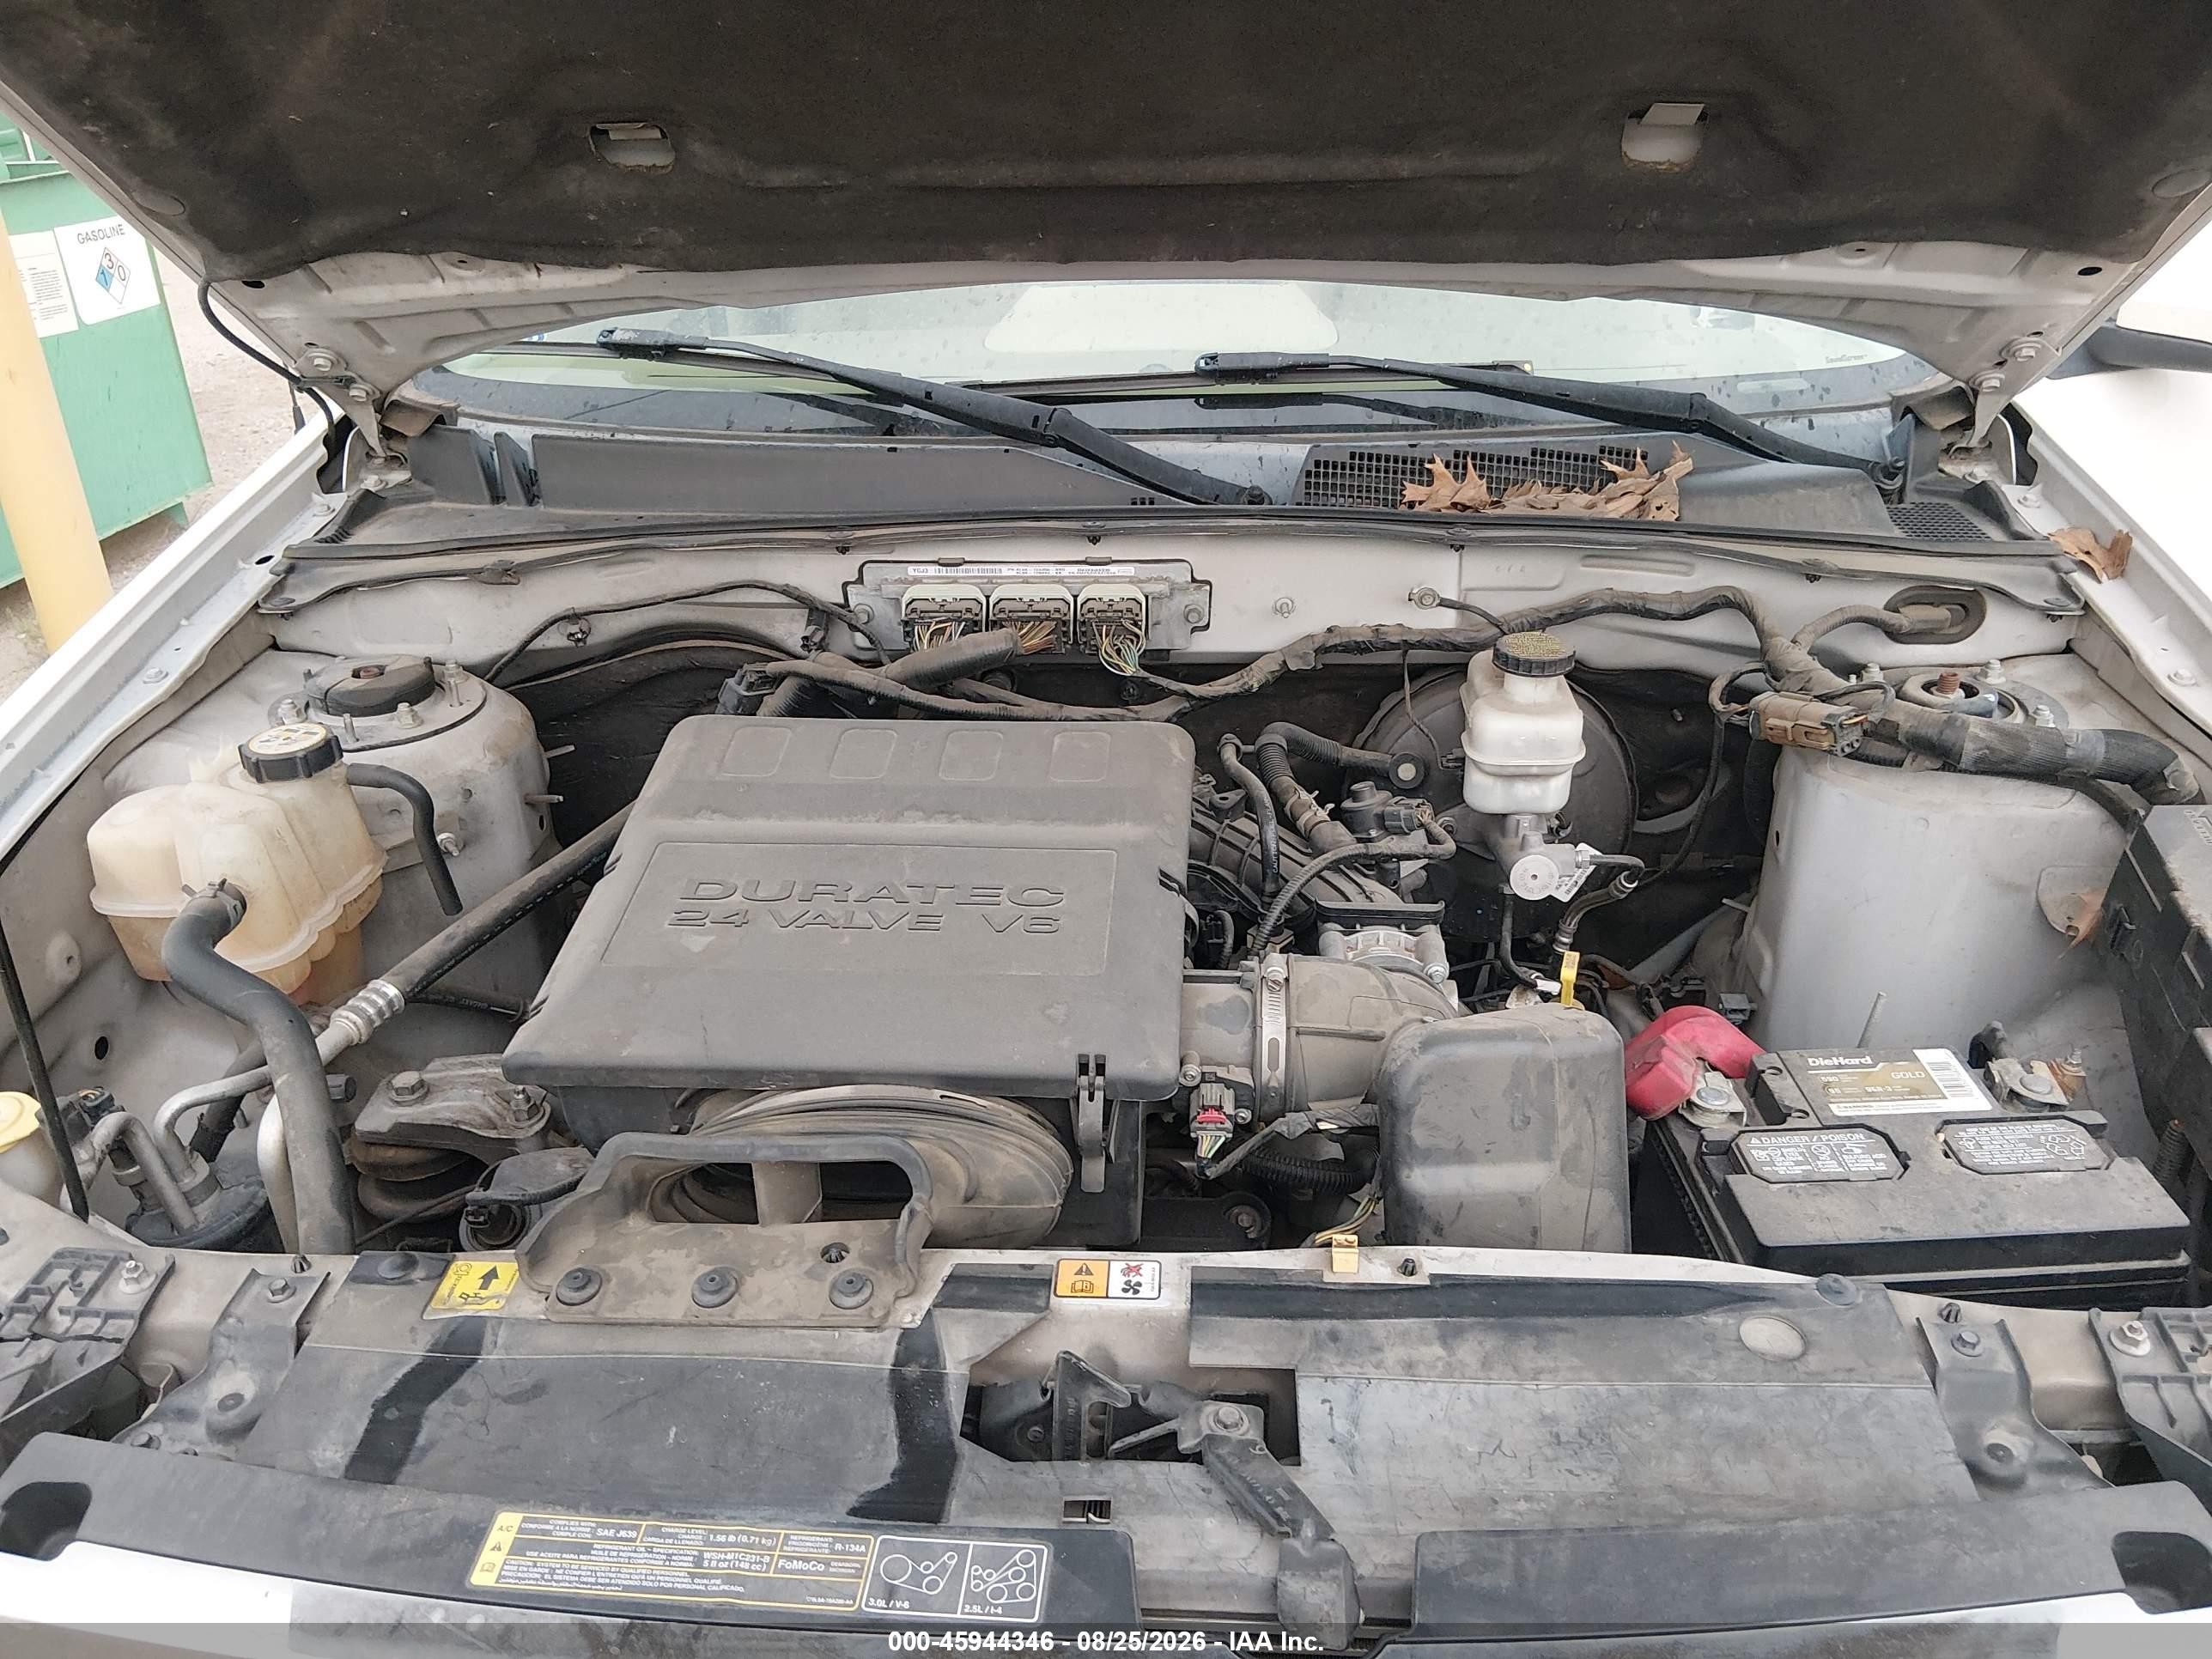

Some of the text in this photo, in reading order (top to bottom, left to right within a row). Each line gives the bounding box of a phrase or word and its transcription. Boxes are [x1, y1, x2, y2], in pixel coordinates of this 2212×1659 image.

[76, 224, 126, 245] GASOLINE
[104, 252, 114, 270] 3
[117, 264, 126, 281] 0
[678, 878, 1065, 908] DURATEC
[666, 908, 1060, 934] 24 VALVE V6
[1807, 1055, 1873, 1066] DieHard
[1891, 1071, 1926, 1079] GOLD
[1760, 1135, 1810, 1144] DANGER
[1820, 1133, 1866, 1142] POISON
[596, 1528, 637, 1539] SAE J639
[708, 1534, 726, 1542] 1.56
[738, 1534, 760, 1544] (0.71
[761, 1536, 776, 1547] kg)
[835, 1543, 866, 1553] R-134A
[703, 1551, 770, 1563] WSH-M1C231-B
[751, 1563, 767, 1571] cc)
[778, 1559, 825, 1571] FoMoCo
[868, 1597, 887, 1607] 3.0L
[896, 1600, 910, 1609] V-6
[963, 1604, 983, 1613] 2.5L
